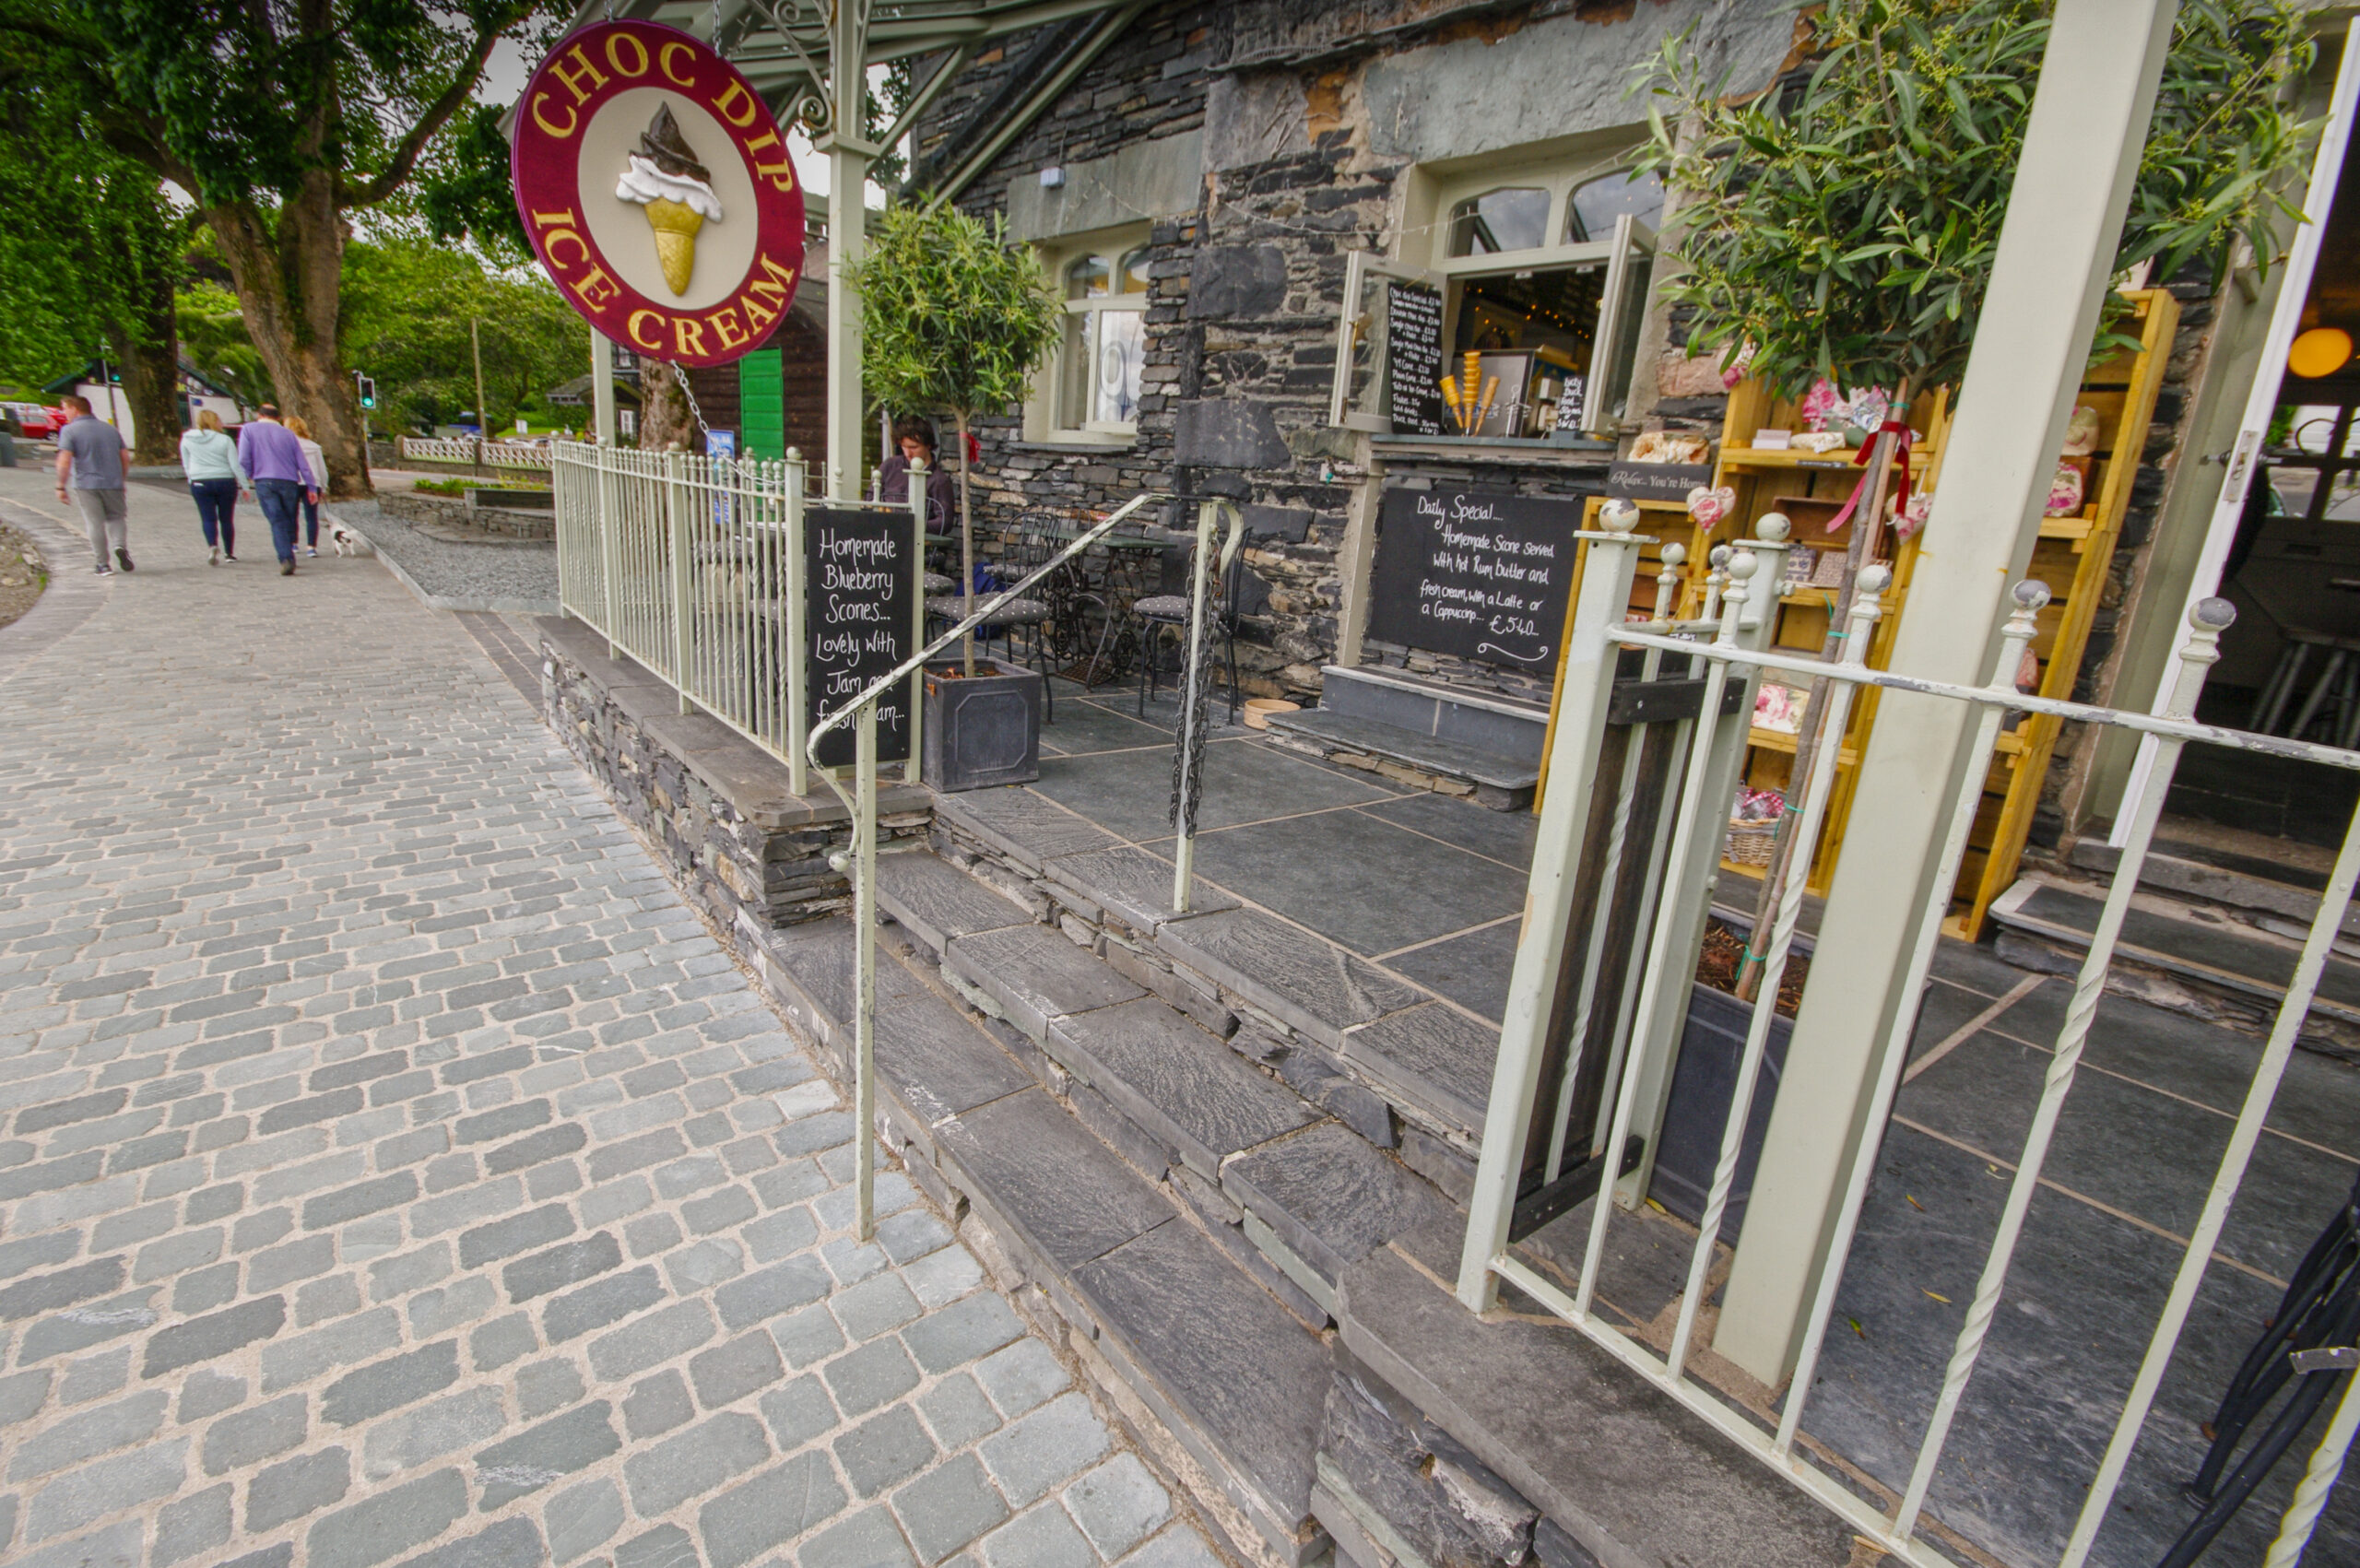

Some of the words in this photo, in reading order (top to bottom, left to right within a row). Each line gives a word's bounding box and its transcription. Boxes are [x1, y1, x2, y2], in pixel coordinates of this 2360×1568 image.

[532, 32, 697, 139] CHOC
[711, 77, 794, 193] DIP
[532, 207, 621, 313] ICE
[628, 252, 796, 357] CREAM
[1650, 475, 1678, 488] You're
[1417, 495, 1446, 530] Daily
[820, 528, 896, 565] Homemade
[1441, 524, 1491, 552] Homemade
[1493, 534, 1521, 554] Scone
[821, 564, 893, 600] Blueberry
[1456, 553, 1469, 573] hot
[1473, 555, 1493, 580] Rum
[1495, 557, 1527, 580] butter
[1528, 568, 1549, 585] and
[1420, 578, 1441, 599] fresh
[1487, 595, 1494, 606] a
[1495, 591, 1524, 609] Latte
[1529, 600, 1544, 611] or
[1422, 603, 1430, 615] a
[816, 632, 860, 667] Lovely
[827, 669, 861, 695] Jam
